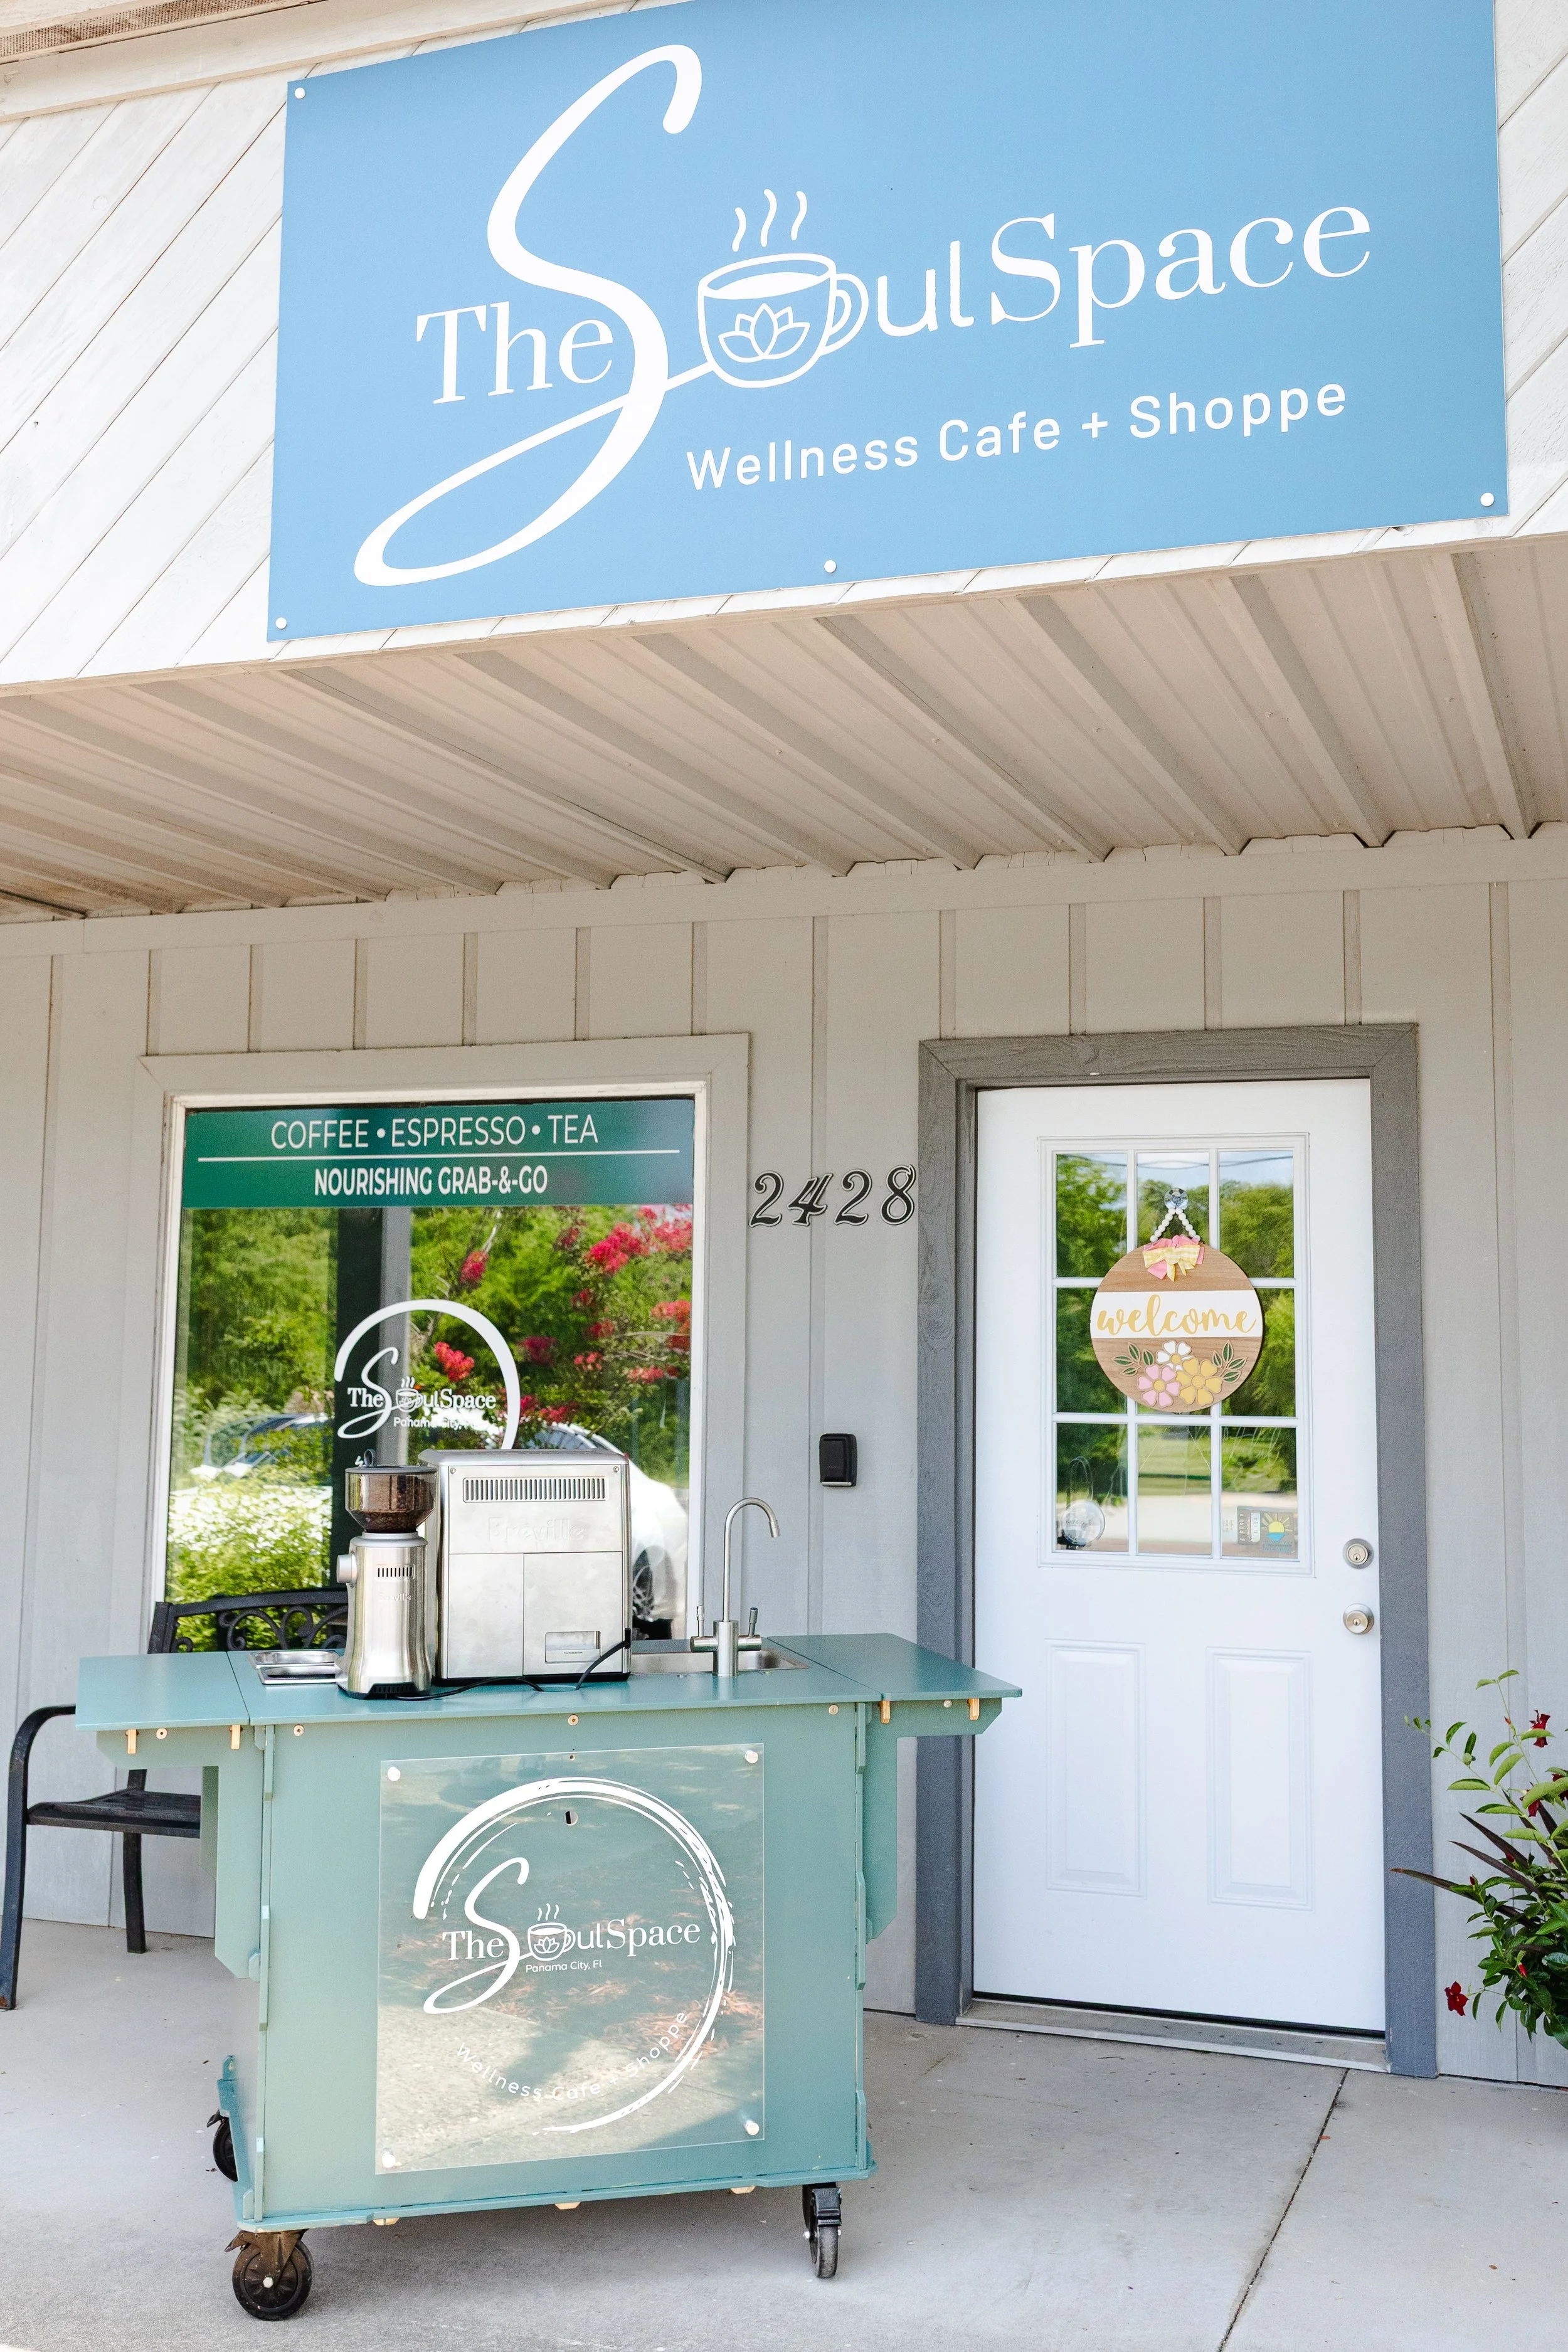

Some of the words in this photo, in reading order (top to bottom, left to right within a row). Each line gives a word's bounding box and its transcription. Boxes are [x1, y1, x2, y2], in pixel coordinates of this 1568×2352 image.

[416, 301, 613, 405] The
[686, 435, 918, 491] Wellness
[939, 411, 1060, 461] Cafe
[1130, 383, 1346, 438] Shoppe
[271, 1119, 369, 1149] COFFEE
[391, 1115, 526, 1147] ESPRESSO
[548, 1114, 599, 1144] TEA
[314, 1166, 432, 1195] NOURISHING
[438, 1165, 548, 1194] GRAB-&-GO
[749, 1164, 916, 1227] 2428
[1096, 1294, 1256, 1337] welcome
[347, 1387, 384, 1407] The
[442, 1930, 504, 1961] The
[526, 1963, 568, 1973] Panama
[570, 1961, 590, 1971] City,
[593, 1959, 602, 1969] Fl
[456, 2043, 543, 2099] Wellness
[552, 2082, 601, 2100] Cafe
[625, 2011, 687, 2077] Shoppe
